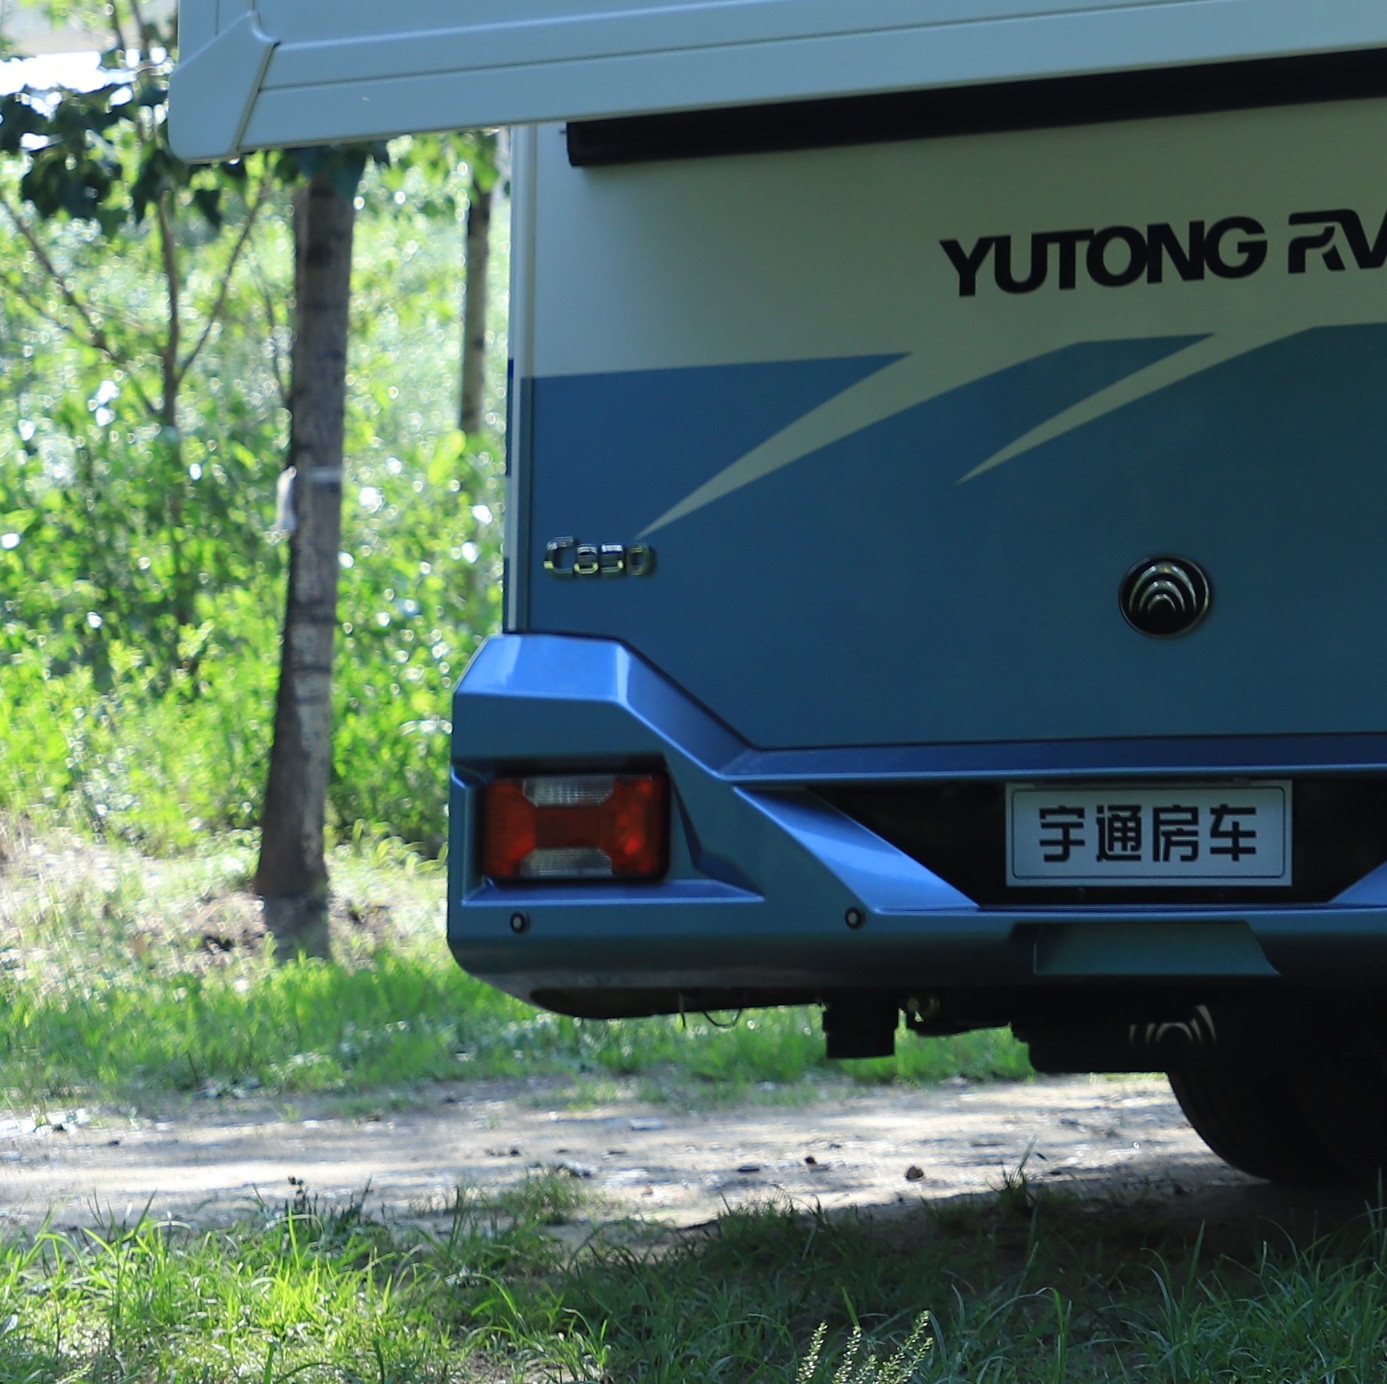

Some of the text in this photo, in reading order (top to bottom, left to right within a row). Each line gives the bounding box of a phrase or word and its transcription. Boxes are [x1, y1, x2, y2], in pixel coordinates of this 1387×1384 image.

[938, 215, 1269, 297] YUTONG
[1038, 803, 1257, 863] 宇通房车
